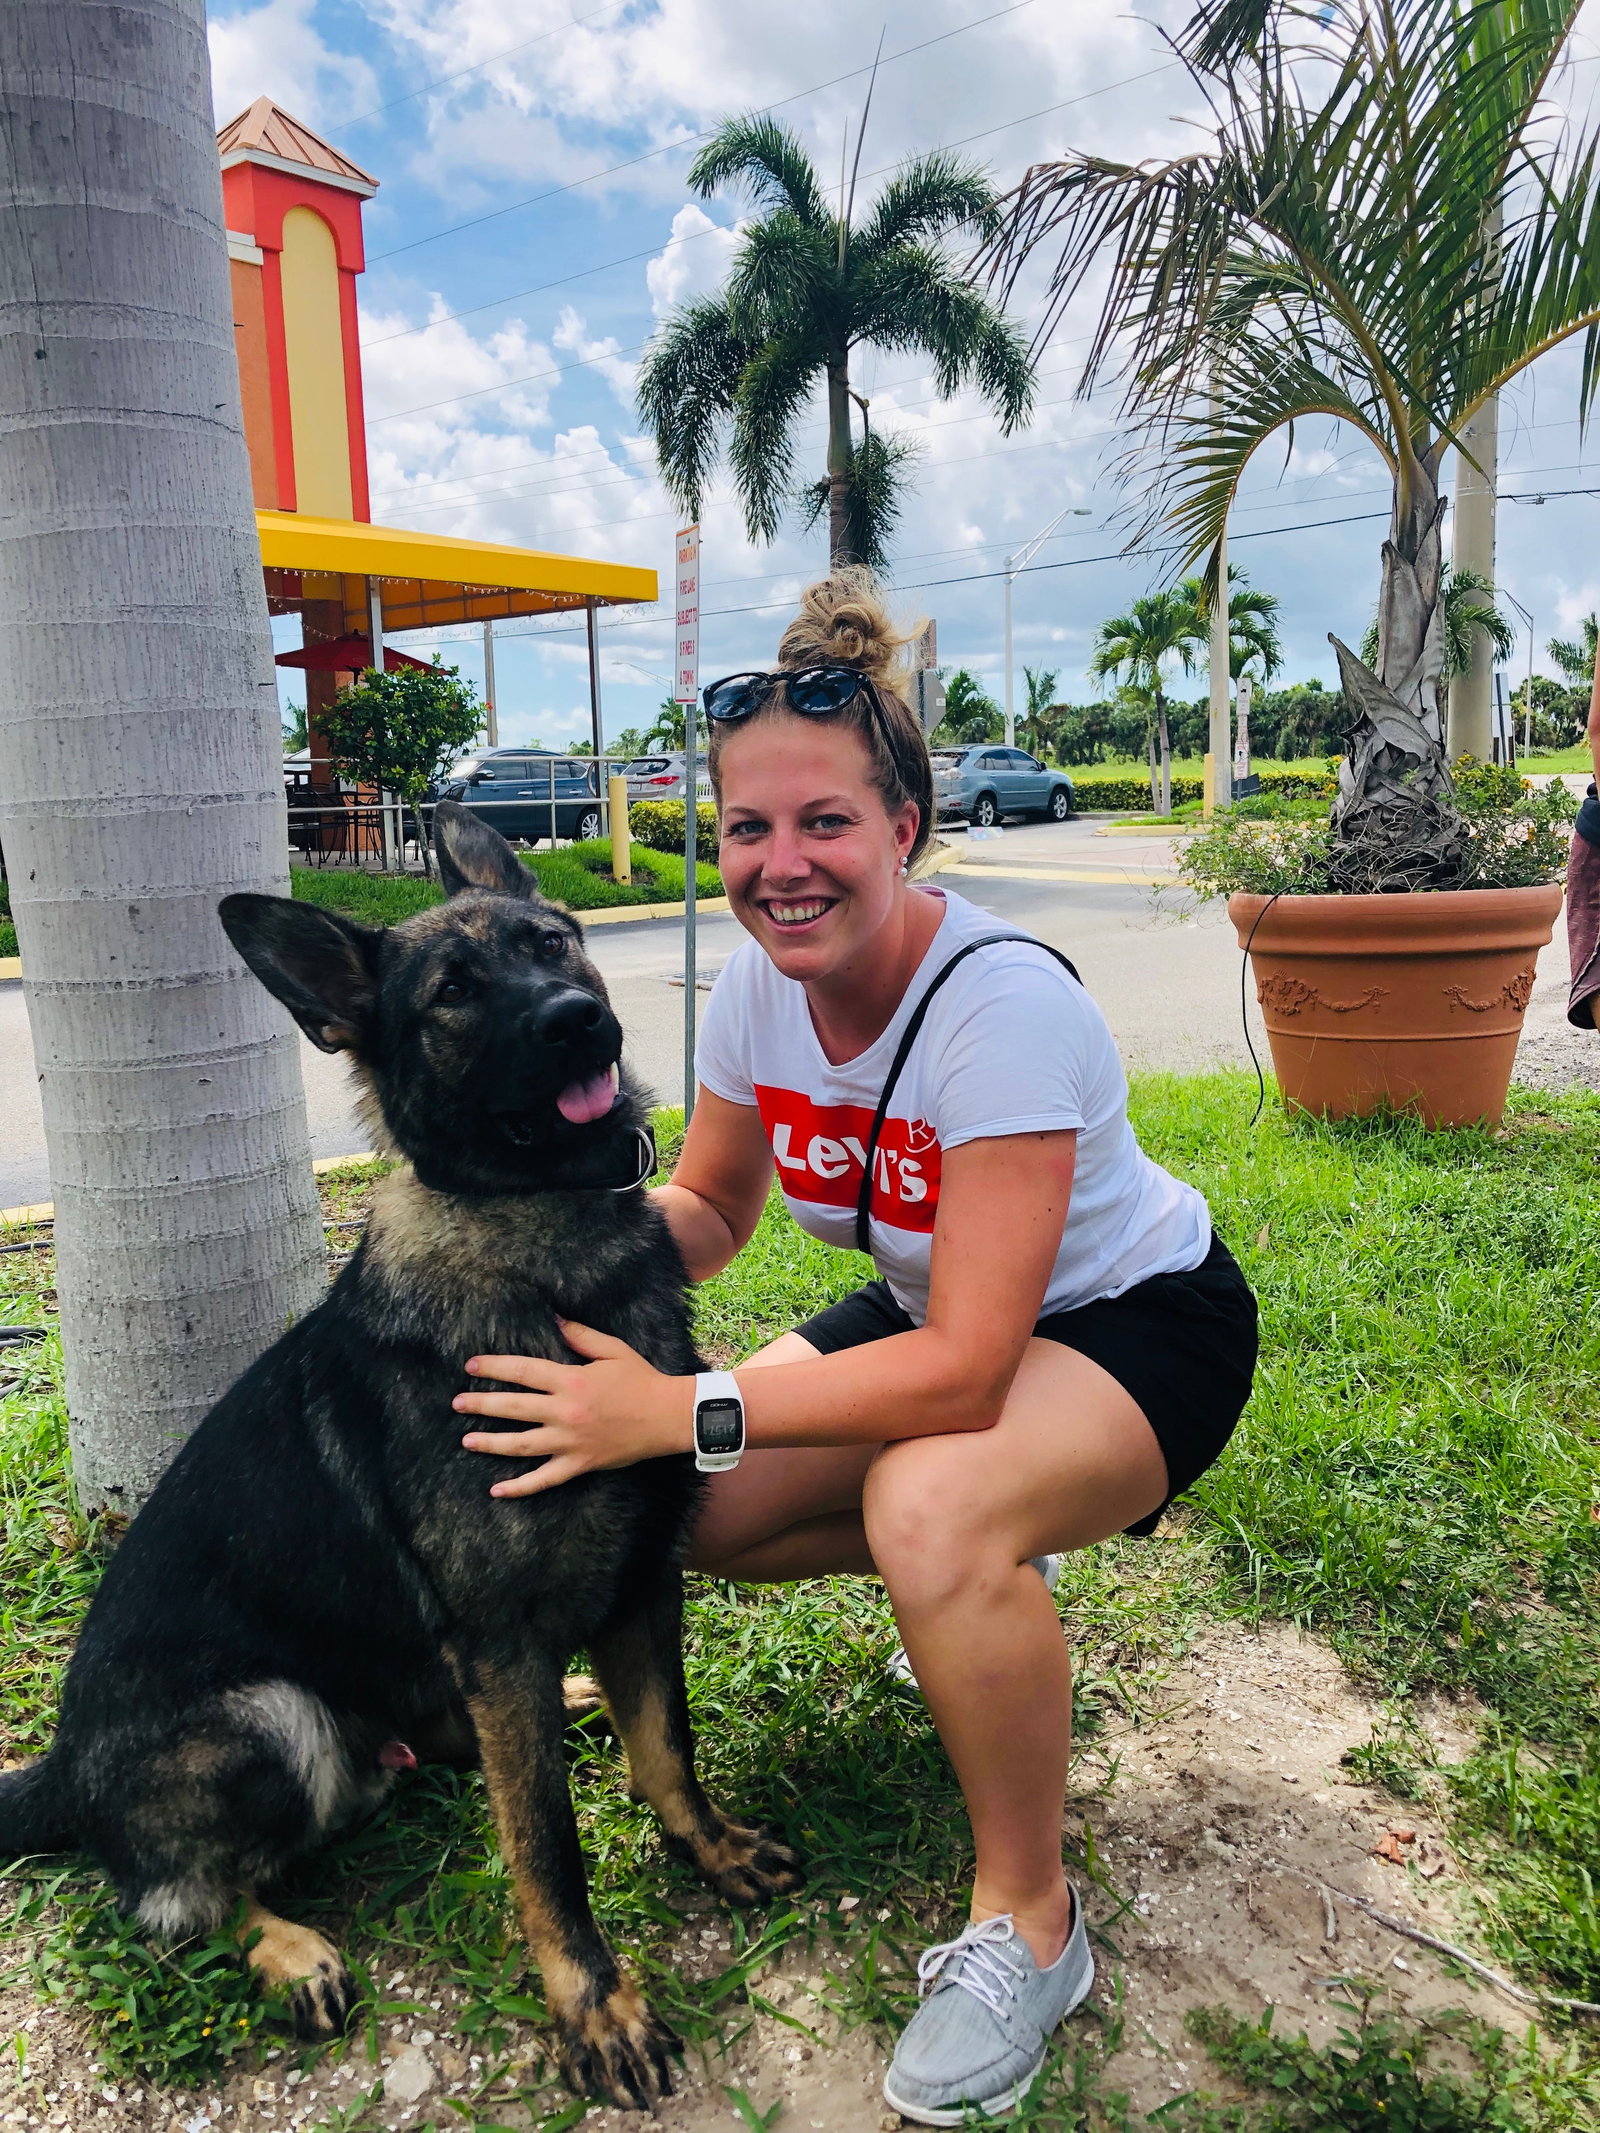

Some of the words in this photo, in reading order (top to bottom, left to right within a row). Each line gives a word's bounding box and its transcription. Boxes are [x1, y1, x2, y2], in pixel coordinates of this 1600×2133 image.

[678, 608, 692, 626] SUBJECT
[693, 607, 697, 623] TO
[772, 1122, 928, 1203] Levi's
